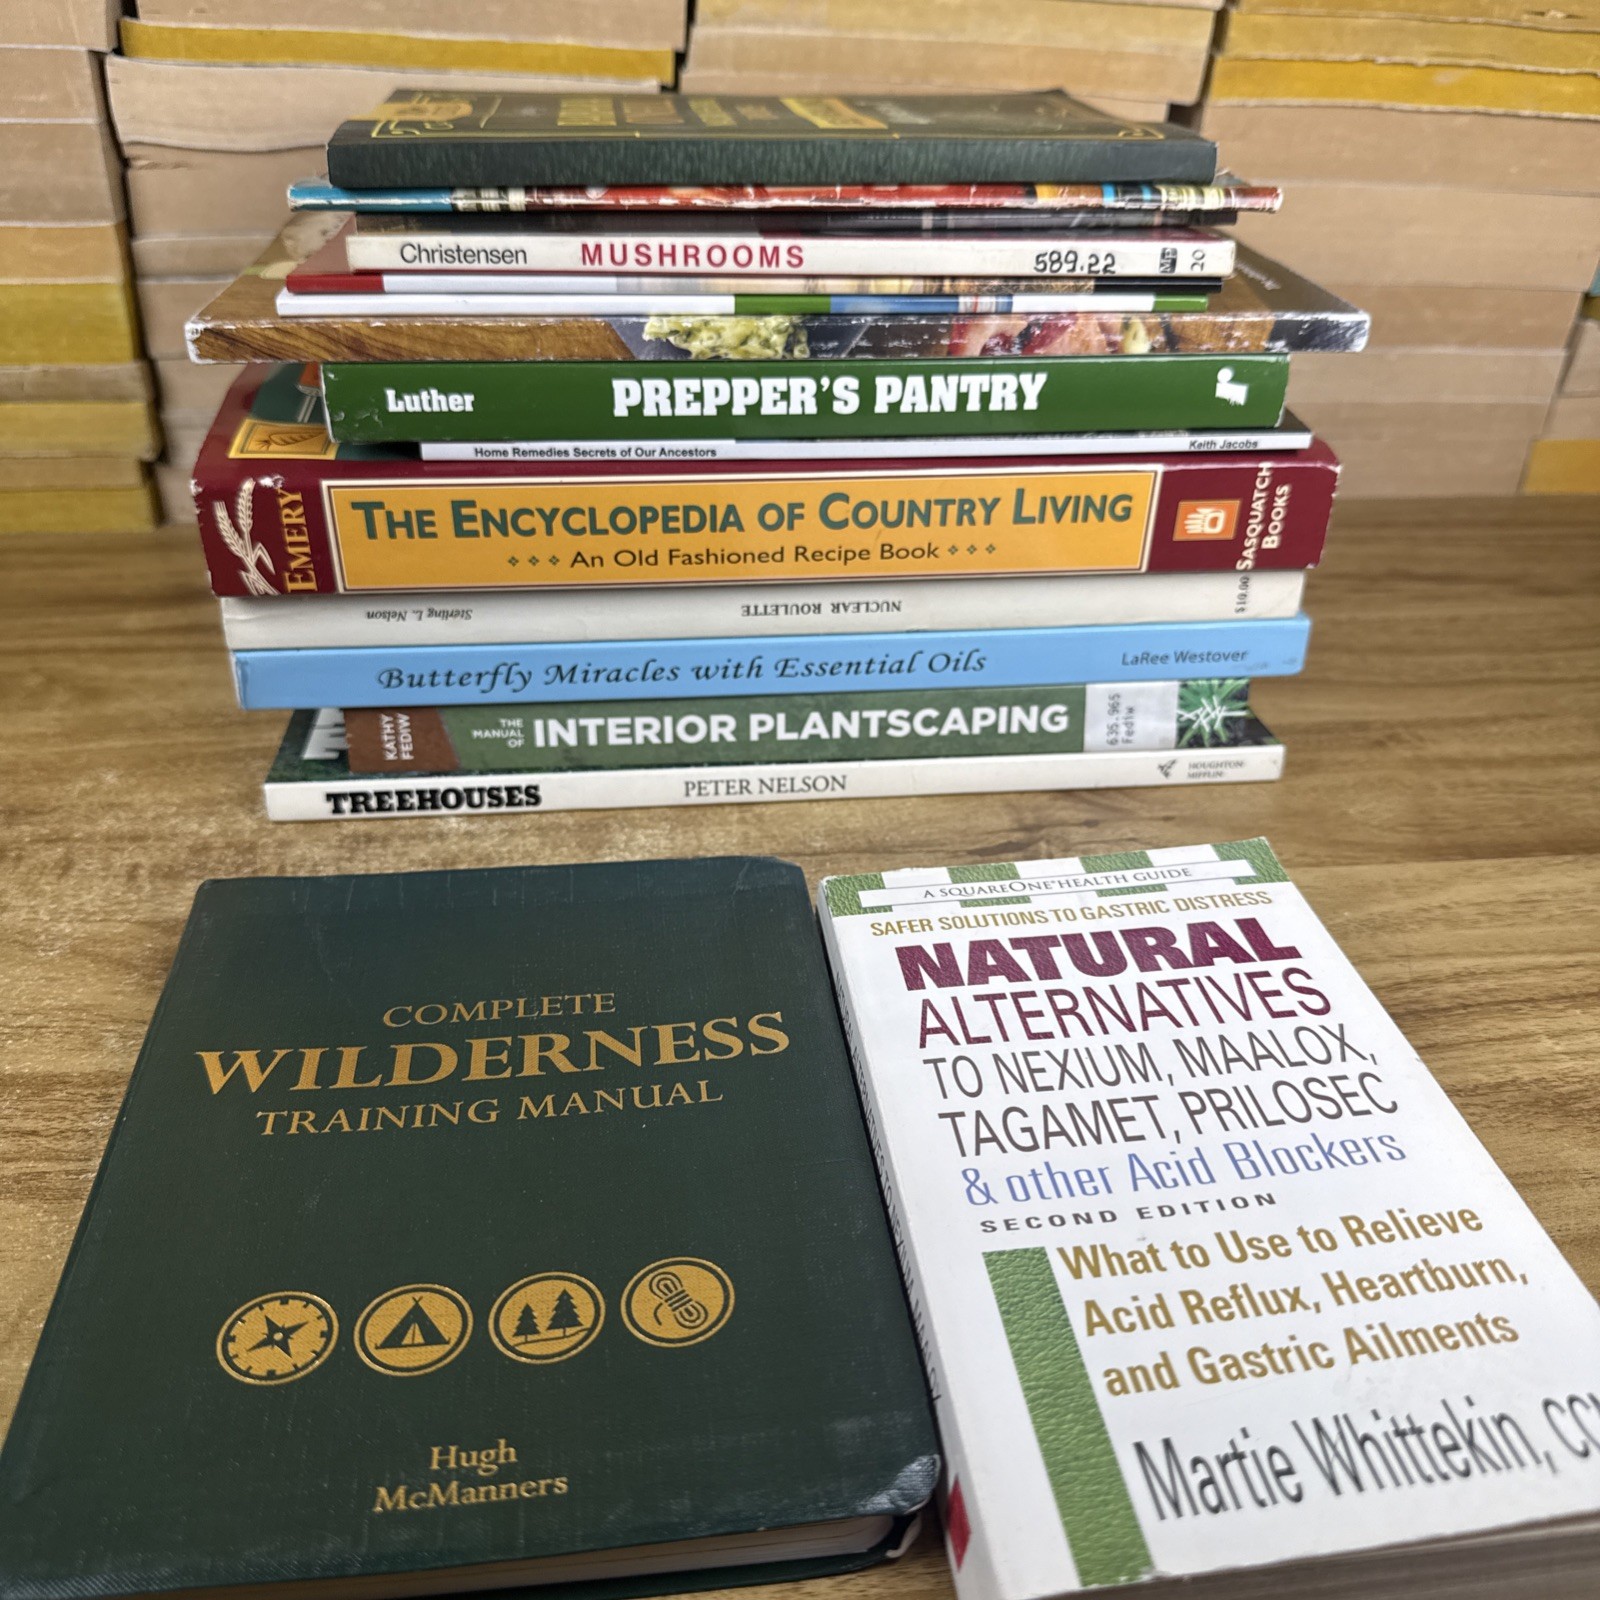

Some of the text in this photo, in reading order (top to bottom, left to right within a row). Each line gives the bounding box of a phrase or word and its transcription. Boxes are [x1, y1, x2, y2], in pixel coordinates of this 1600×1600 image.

[400, 242, 528, 266] Christensen
[580, 243, 805, 272] MUSHROOMS
[1034, 250, 1116, 275] 589.22
[1191, 249, 1206, 272] 20
[385, 389, 475, 413] Luther
[612, 372, 1048, 418] PREPPER’S PANTRY
[475, 447, 717, 458] Home Remedies Secrets of Our Ancestors
[1189, 440, 1258, 450] Keith Jacobs
[351, 488, 1132, 540] THE ENCYCLOPEDIA OF COUNTRY LIVING
[1236, 461, 1273, 571] SASQUATCH
[1261, 484, 1291, 549] BOOKS
[277, 487, 318, 593] EMERY
[570, 543, 940, 568] An Old Fashioned Recipe Book
[366, 608, 473, 622] Sterling L. Nelson
[741, 600, 902, 616] NUCLEAR ROULETTE
[1234, 575, 1251, 614] $10.00
[377, 648, 988, 692] Butterfly Miracles with Essential Oils
[1122, 650, 1248, 666] LaRee Westover
[379, 714, 400, 760] KATHY
[397, 712, 415, 761] FEDIW
[472, 728, 525, 738] MANUAL
[499, 718, 525, 728] THE
[534, 704, 1070, 748] INTERIOR PLANTSCAPING
[1106, 692, 1121, 746] 635.965
[507, 738, 525, 748] OF
[1188, 760, 1245, 770] HOUGHTON
[1188, 770, 1224, 779] MIFFLIN
[325, 785, 542, 815] TREEHOUSES
[684, 775, 848, 798] PETER NELSON
[924, 890, 936, 899] A
[1135, 867, 1192, 883] GUIDE
[871, 890, 1273, 938] SAFER SOLUTIONS TO GASTRIC DISTRESS
[895, 918, 1303, 990] NATURAL
[383, 993, 617, 1028] COMPLETE
[919, 967, 1332, 1049] ALTERNATIVES
[195, 1011, 790, 1095] WILDERNESS
[923, 1022, 1378, 1100] TO NEXIUM, MAALOX,
[256, 1079, 723, 1136] TRAINING MANUAL
[938, 1070, 1398, 1158] TAGAMET, PRILOSEC
[961, 1130, 1406, 1206] & other Acid Blockers
[980, 1191, 1278, 1234] SECOND EDITION
[1057, 1206, 1484, 1281] What to Use to Relieve
[1083, 1256, 1529, 1337] Acid Reflux, Heartburn,
[1103, 1310, 1520, 1397] and Gastric Ailments
[431, 1439, 519, 1477] Hugh
[1132, 1427, 1304, 1522] Martie
[1291, 1395, 1558, 1500] Whittekin,
[373, 1477, 570, 1514] McManners
